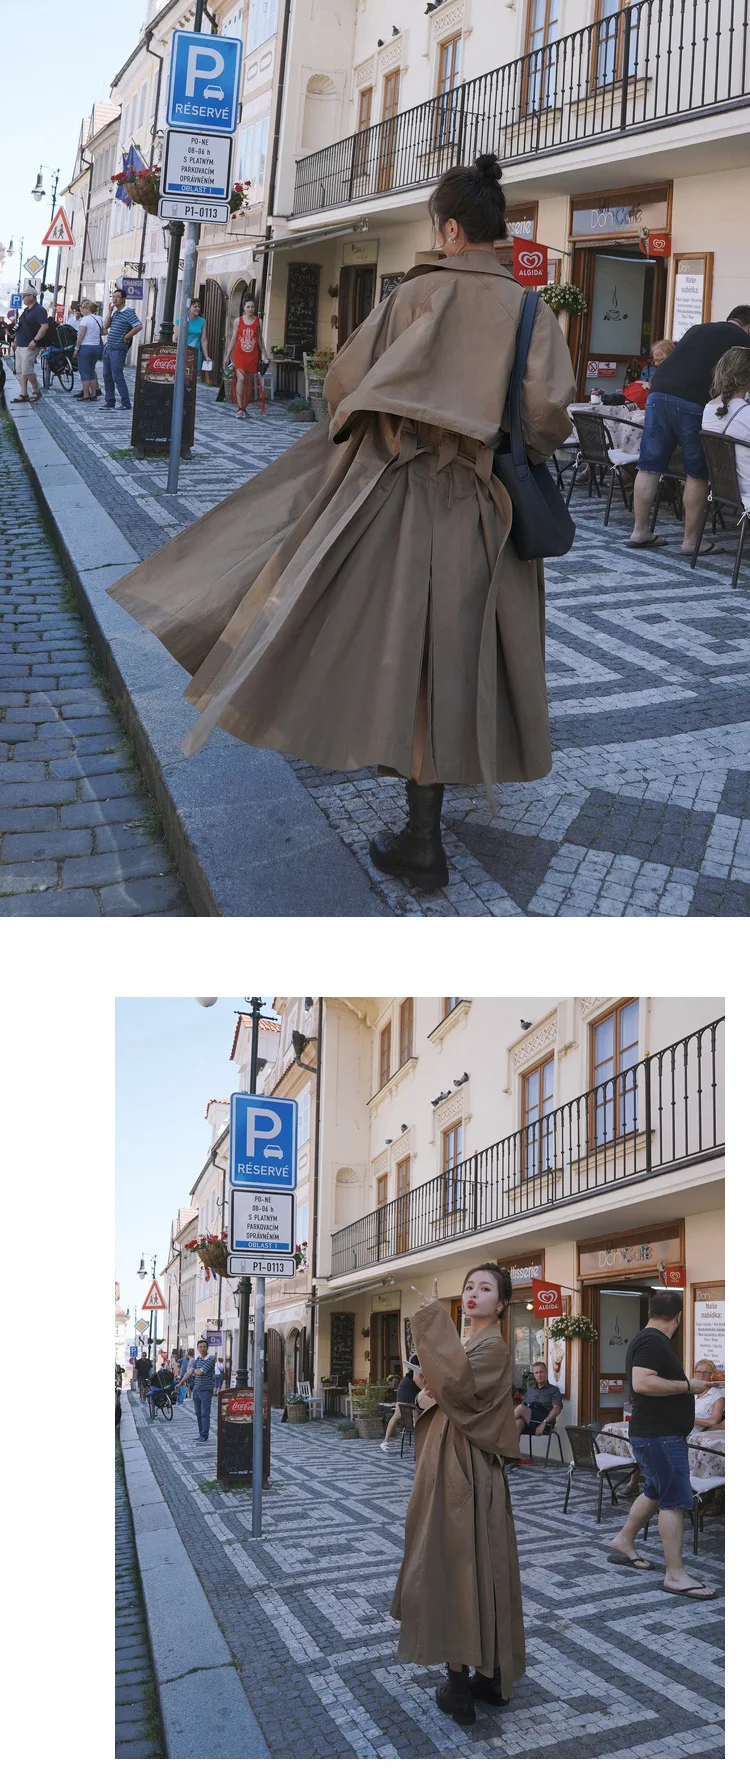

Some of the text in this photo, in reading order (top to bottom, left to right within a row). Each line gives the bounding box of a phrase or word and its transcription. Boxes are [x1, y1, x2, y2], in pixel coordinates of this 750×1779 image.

[185, 45, 225, 97] P
[175, 102, 229, 120] RÉSERVÉ
[191, 138, 209, 146] PO-NE
[188, 147, 205, 155] 08-06
[190, 156, 214, 165] PLATNÝM
[181, 166, 215, 175] PARKOVACÍM
[180, 175, 215, 184] OPRÁVNĚNÍM
[185, 206, 218, 218] P1-0113
[591, 210, 614, 228] Don
[246, 1106, 282, 1157] P
[238, 1162, 290, 1178] RÉSERVÉ
[254, 1214, 278, 1222] PLATNÝM
[246, 1223, 278, 1231] PARKOVACÍM
[246, 1232, 280, 1240] OPRÁVNĚNÍM
[599, 1251, 622, 1268] Don
[253, 1262, 284, 1272] P1-0113
